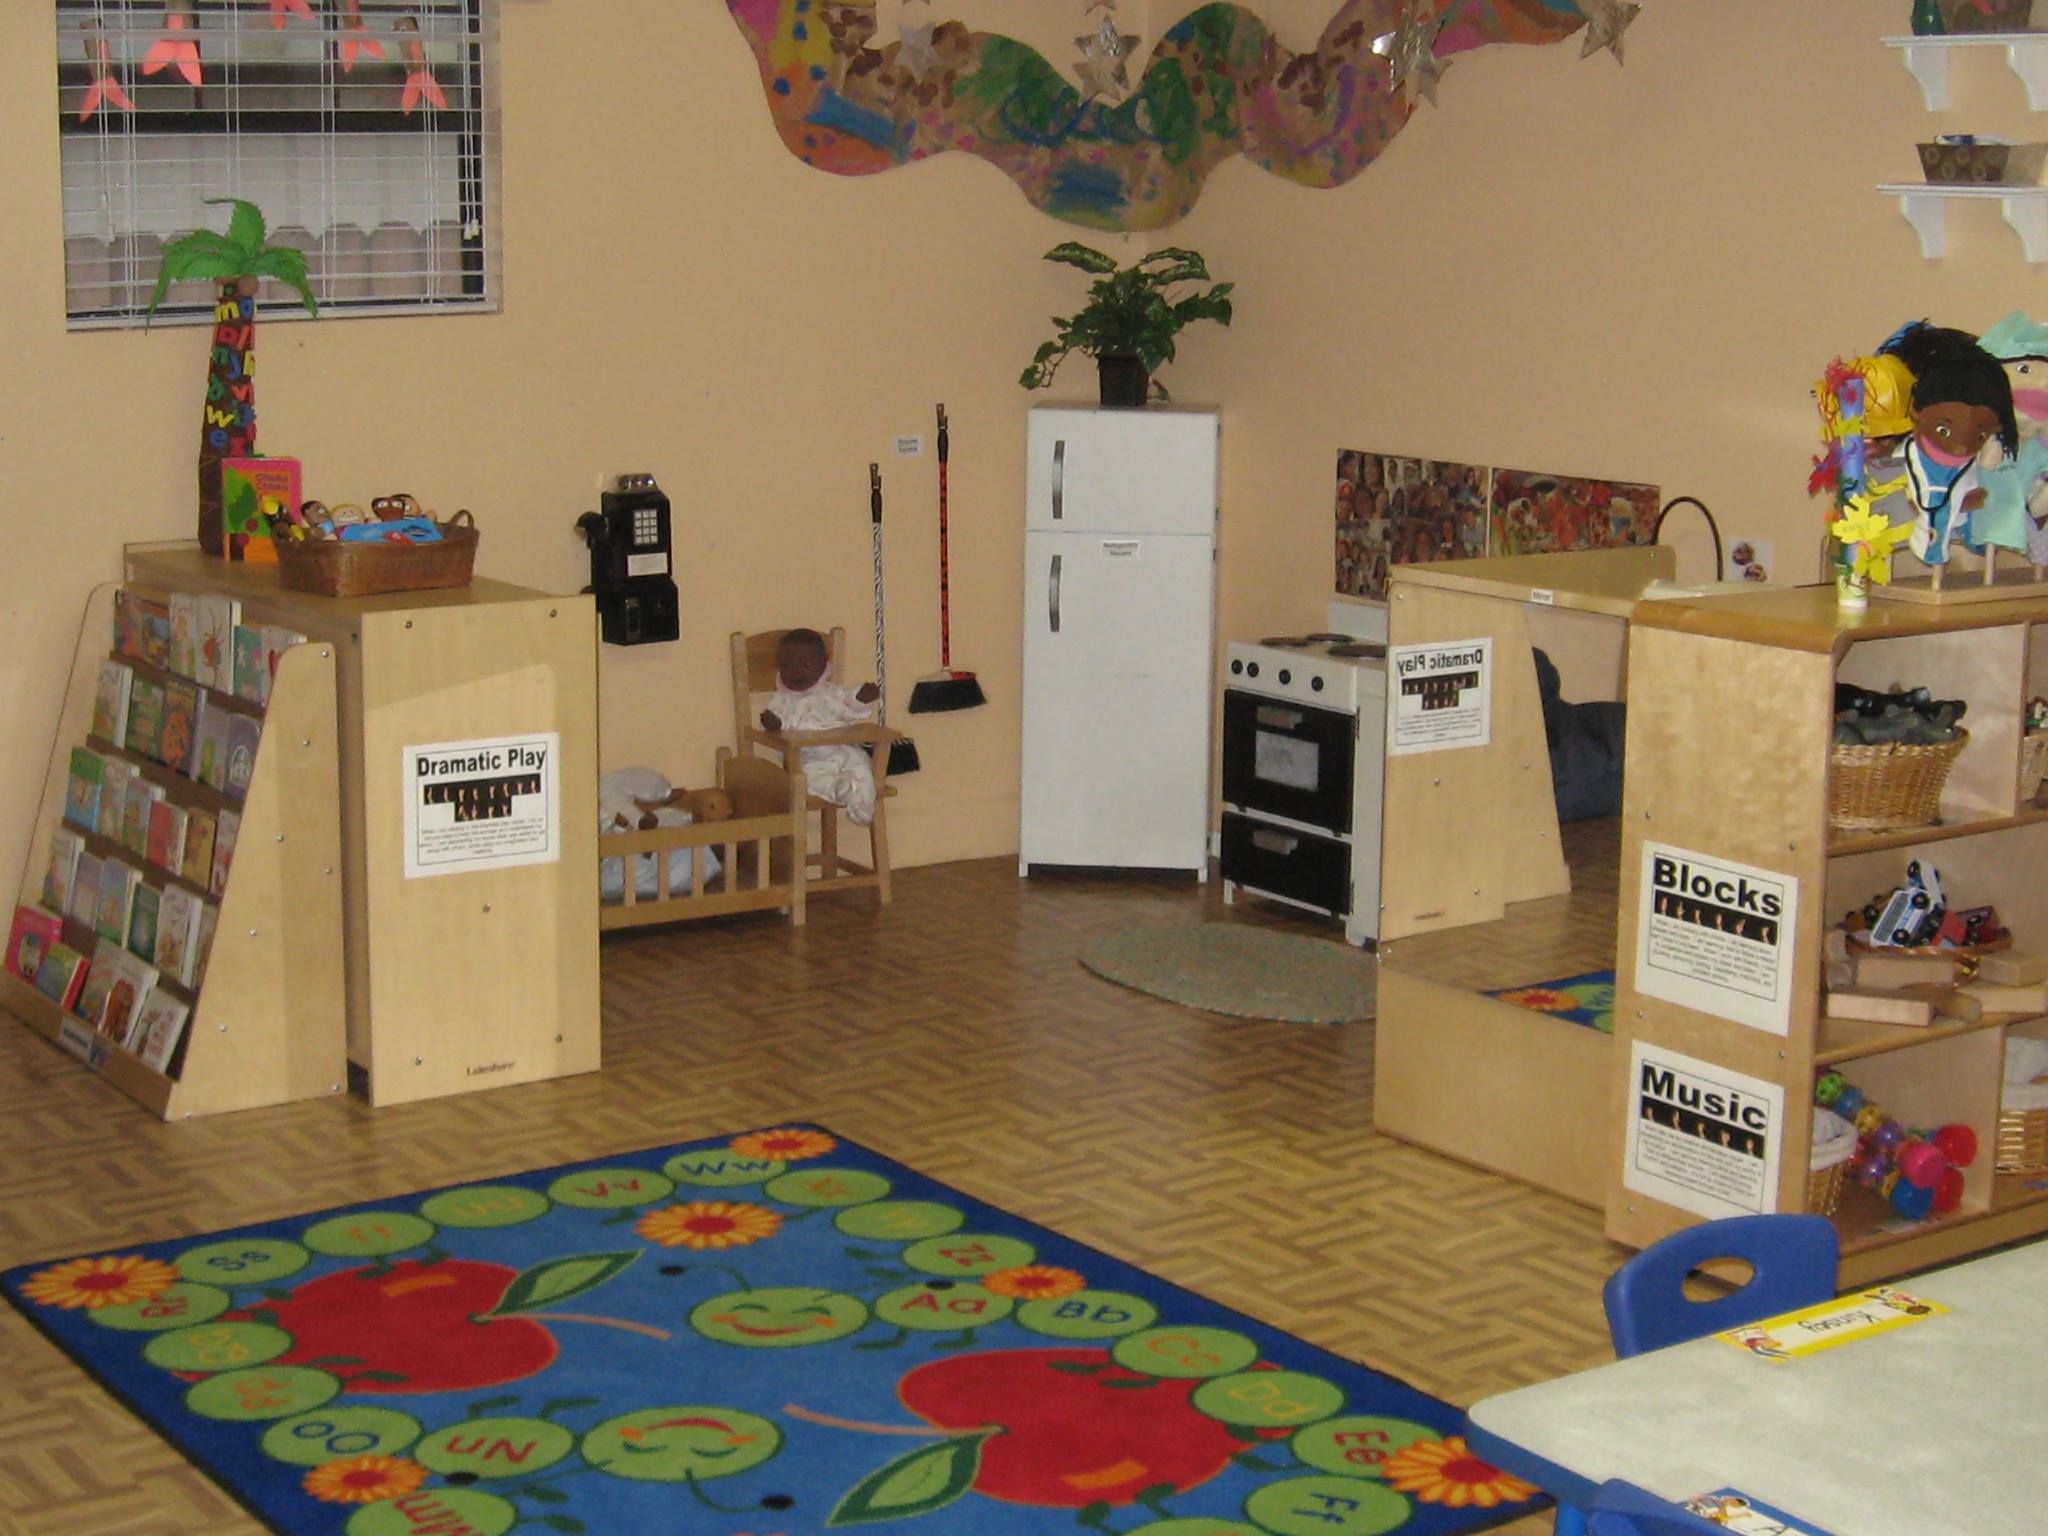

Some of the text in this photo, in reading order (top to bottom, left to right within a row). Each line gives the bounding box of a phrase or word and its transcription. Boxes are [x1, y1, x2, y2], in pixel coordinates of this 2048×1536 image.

[418, 747, 547, 777] Dramatic Play
[1653, 856, 1782, 916] Blocks
[1641, 1064, 1767, 1130] Music
[1052, 1300, 1132, 1324] Bb
